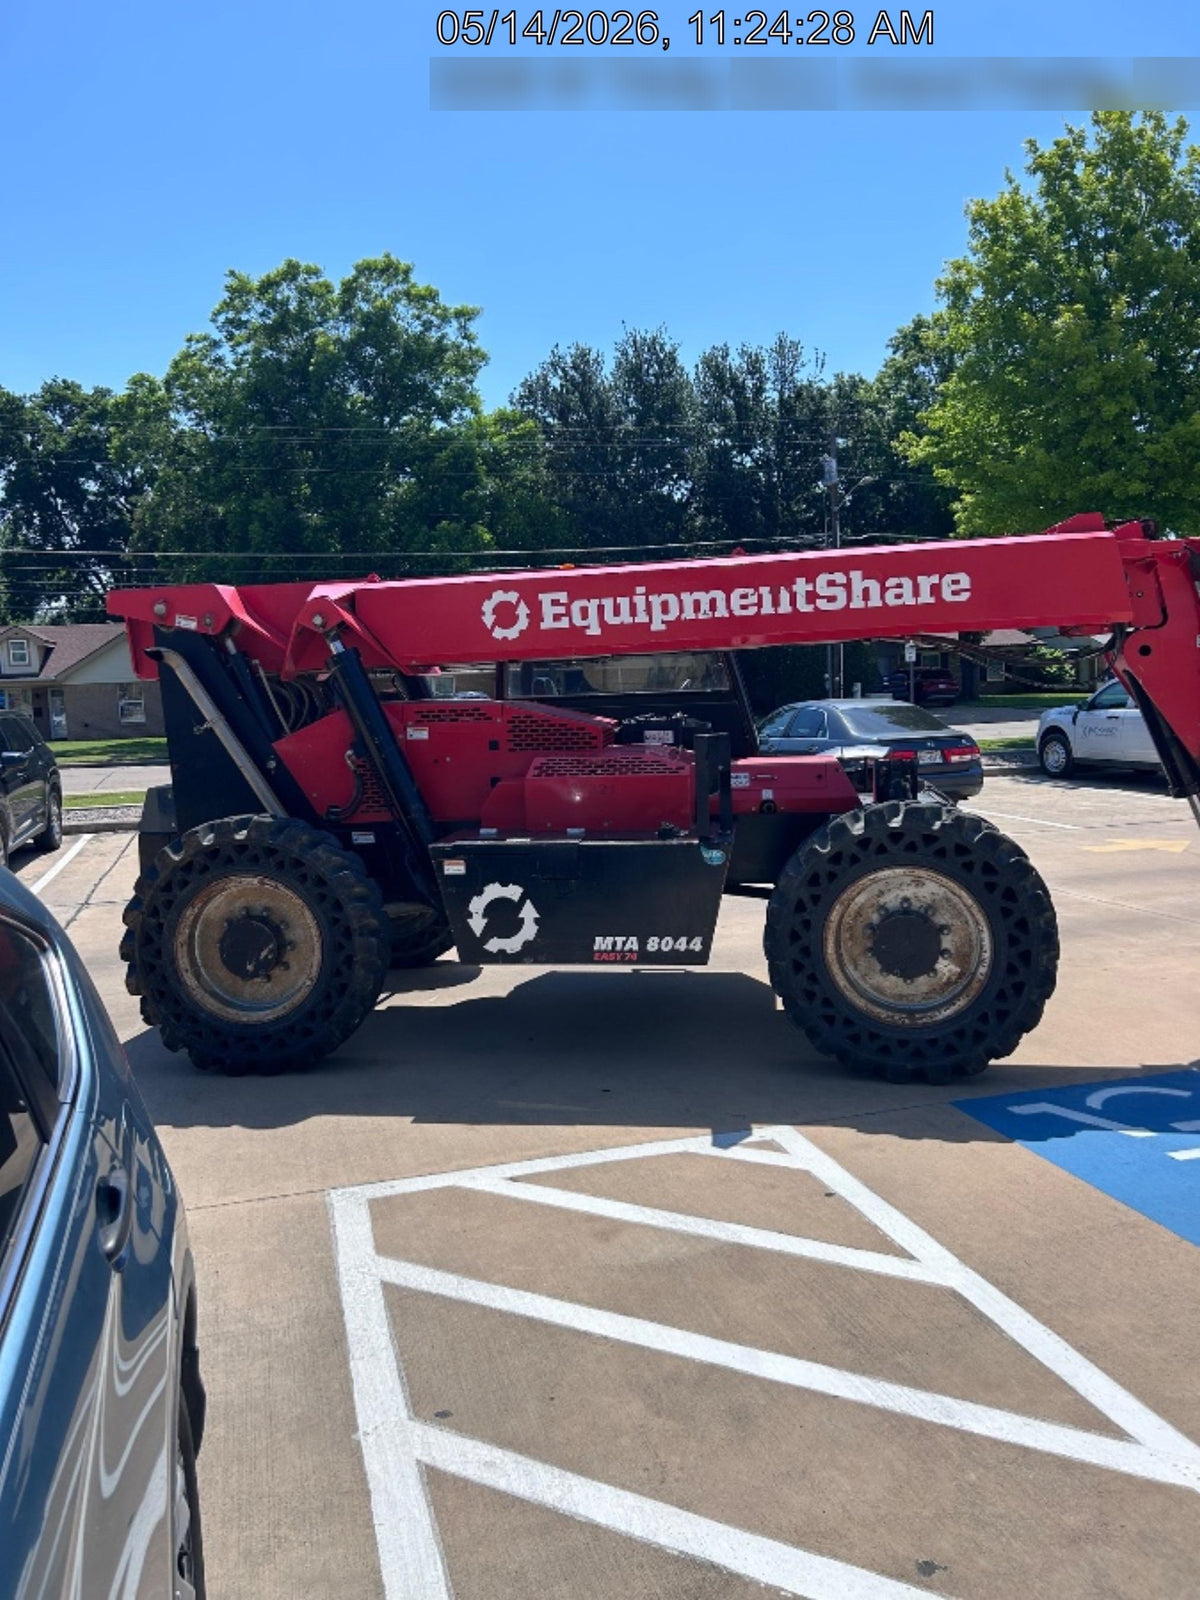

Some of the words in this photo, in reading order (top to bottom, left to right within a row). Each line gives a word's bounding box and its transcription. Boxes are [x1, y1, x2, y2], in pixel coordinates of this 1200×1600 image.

[539, 571, 972, 635] EquipmentShare
[593, 936, 639, 951] MTA
[646, 936, 703, 952] 8044
[593, 952, 623, 961] EASY
